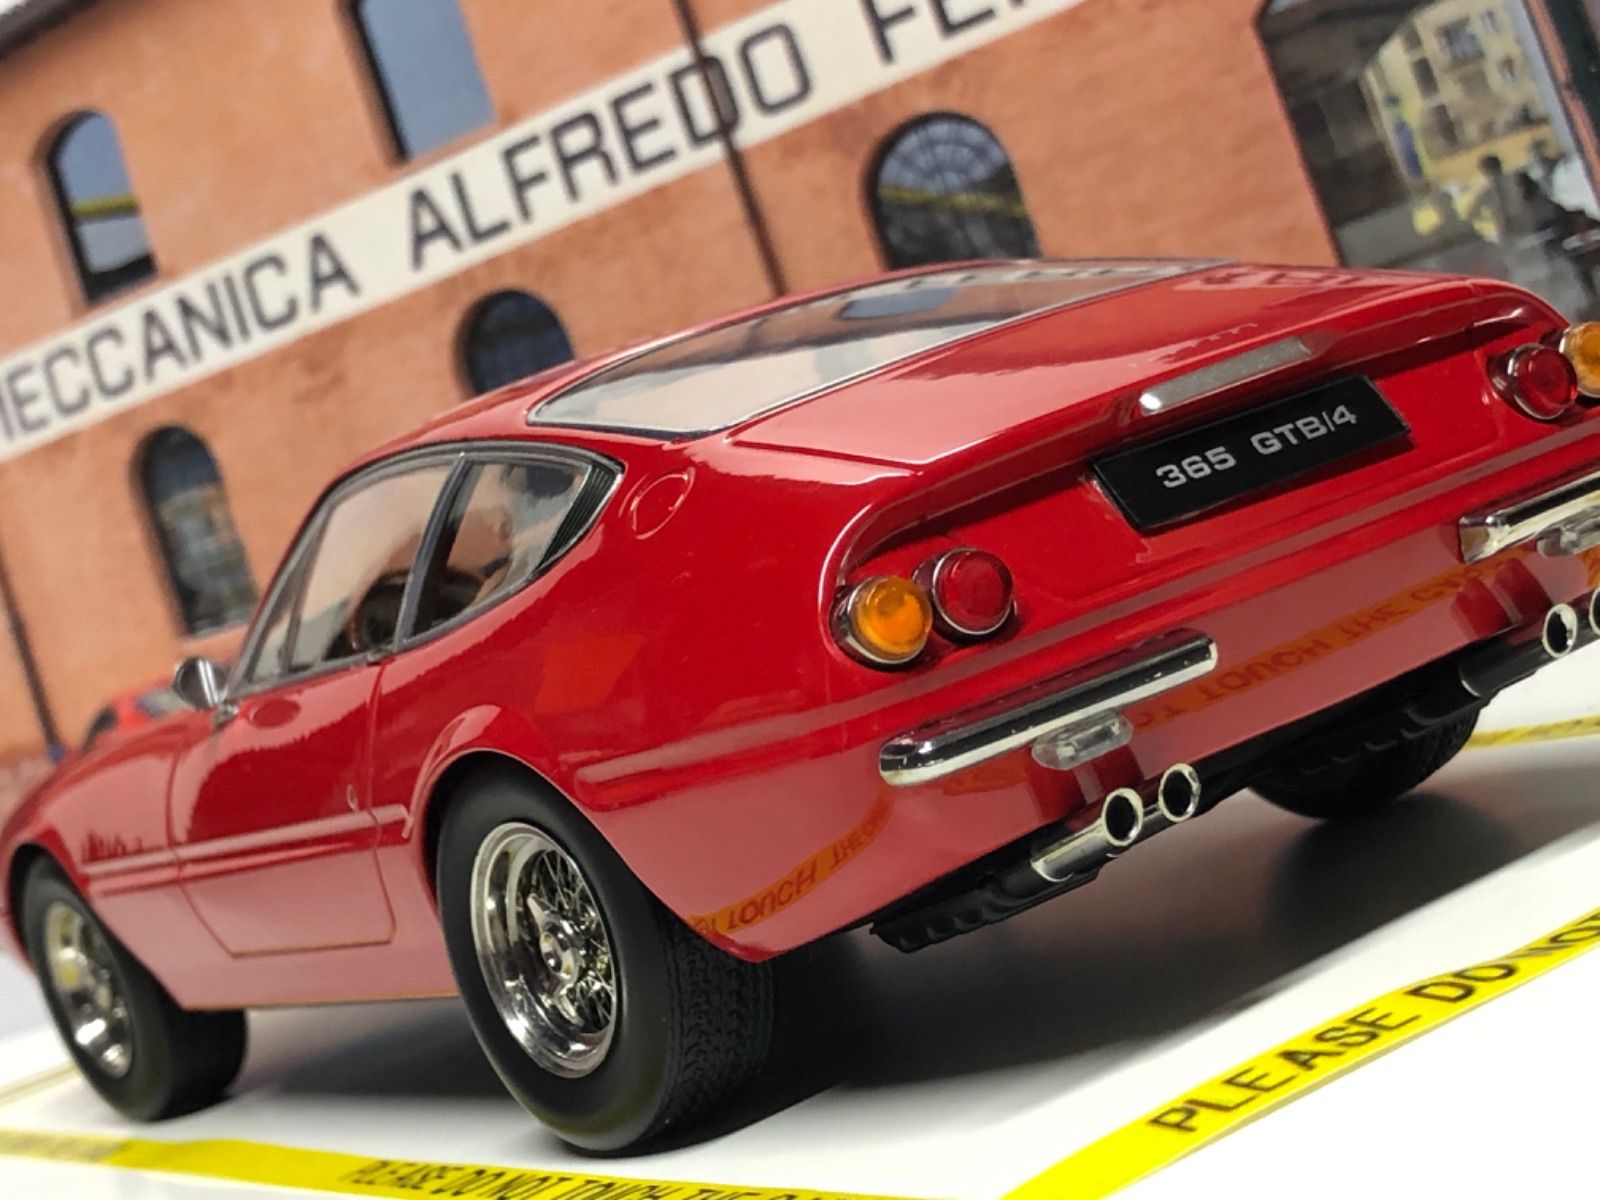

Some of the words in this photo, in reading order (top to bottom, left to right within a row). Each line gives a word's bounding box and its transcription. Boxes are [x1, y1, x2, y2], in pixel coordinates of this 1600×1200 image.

[408, 24, 812, 273] ALFREDO
[1156, 446, 1237, 488] 365
[1250, 404, 1357, 455] GTB/4
[1146, 1007, 1423, 1132] PLEASE
[1402, 963, 1517, 1003] DO
